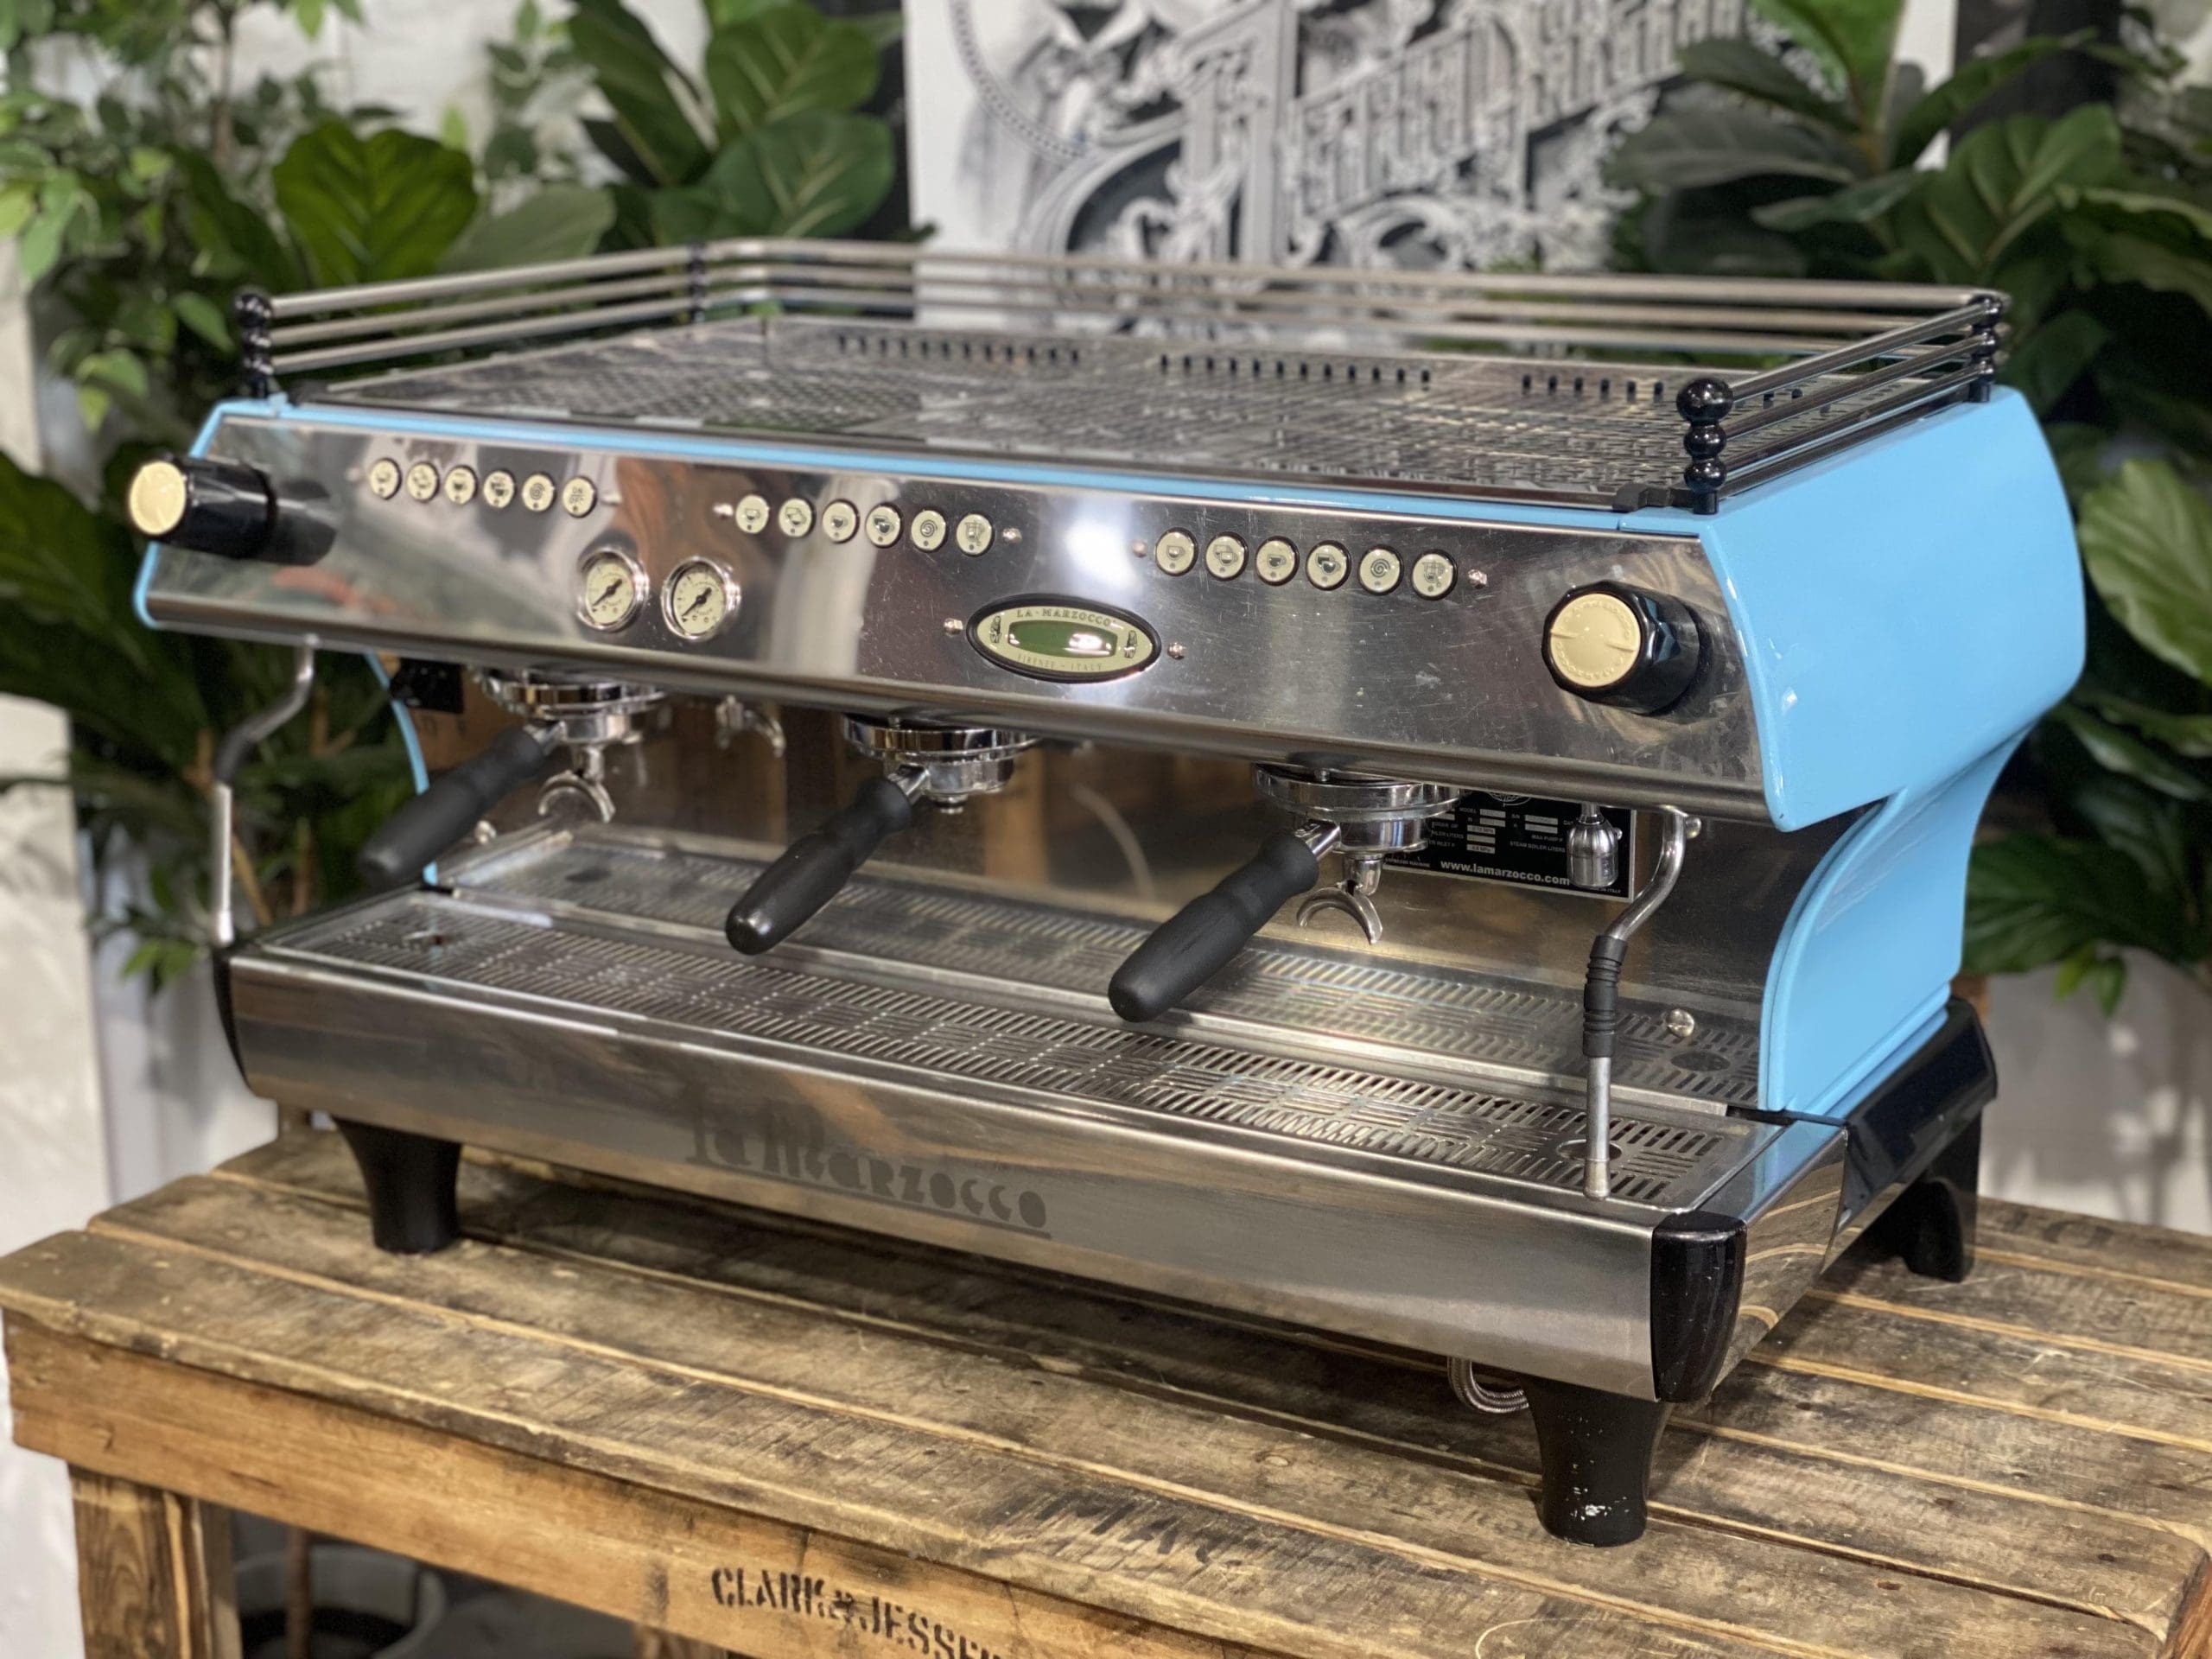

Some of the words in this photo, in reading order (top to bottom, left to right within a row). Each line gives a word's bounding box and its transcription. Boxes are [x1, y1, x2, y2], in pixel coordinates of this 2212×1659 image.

[1017, 607, 1033, 618] LA
[1042, 607, 1112, 627] MARZOCCO
[1018, 653, 1055, 667] FIRENZE
[1071, 663, 1103, 672] ITALY
[1440, 861, 1570, 886] www.lamarzocco.com
